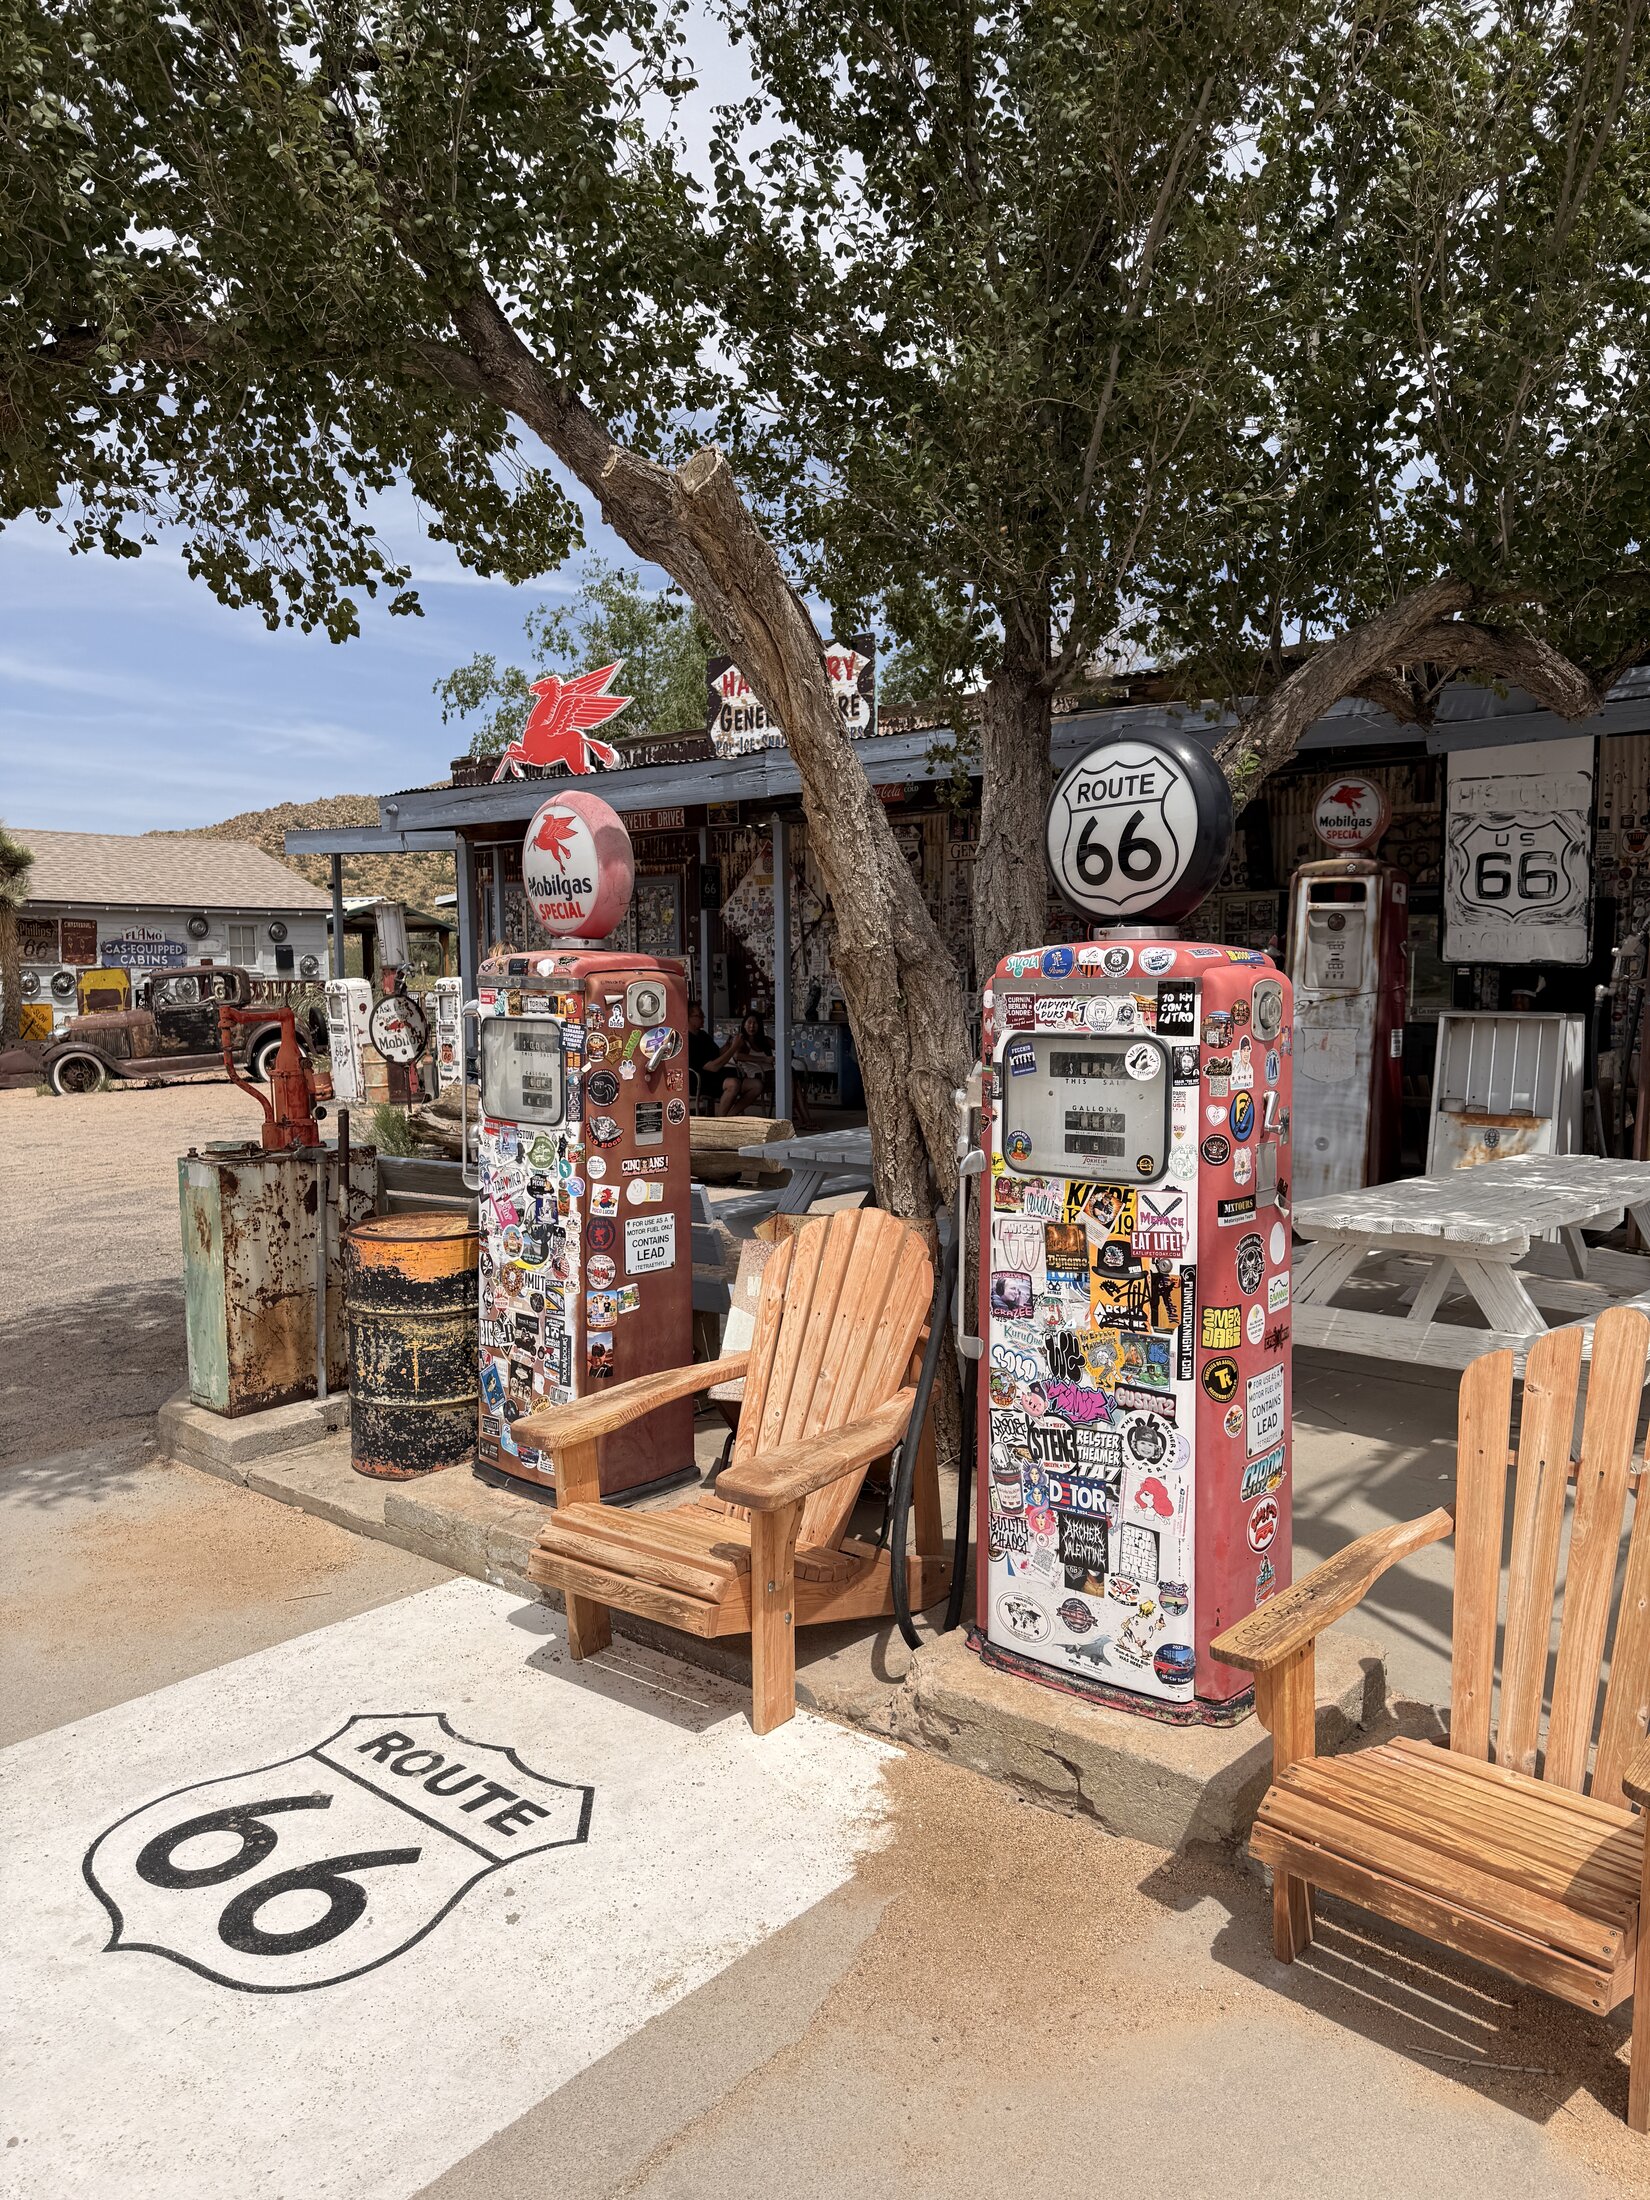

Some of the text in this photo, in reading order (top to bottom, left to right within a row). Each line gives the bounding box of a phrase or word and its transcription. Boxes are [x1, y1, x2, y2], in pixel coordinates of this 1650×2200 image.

[1077, 773, 1155, 804] ROUTE
[618, 810, 681, 829] RVETTE DRIVE
[1319, 815, 1373, 830] Mobilgas
[1326, 829, 1363, 840] SPECIAL
[1495, 833, 1536, 846] US
[1076, 810, 1162, 886] 66
[1476, 851, 1558, 900] 66
[528, 874, 593, 901] Mobilgas
[704, 884, 717, 894] 66
[538, 901, 585, 920] SPECIAL
[125, 928, 162, 941] FLAMO
[24, 939, 49, 959] 66
[105, 943, 183, 955] GAS-EQUIPPED
[120, 954, 168, 965] CABINS
[1162, 993, 1193, 1003] 10 KM
[1161, 1003, 1182, 1012] CON
[1159, 1011, 1194, 1024] LITRO
[1072, 1105, 1119, 1113] GALLONS
[1224, 1198, 1253, 1214] MXTOURS
[632, 1220, 644, 1228] FOR
[644, 1219, 656, 1227] USE
[656, 1218, 663, 1226] AS
[1140, 1212, 1184, 1226] MENACE
[627, 1228, 645, 1237] MOTOR
[646, 1226, 660, 1234] FUEL
[632, 1234, 669, 1248] CONTAINS
[1132, 1232, 1181, 1251] EAT LIFE!
[637, 1246, 665, 1261] LEAD
[1252, 1394, 1282, 1418] CONTAINS
[1257, 1413, 1278, 1436] LEAD
[1121, 1416, 1176, 1449] THE ARCHER
[354, 1730, 552, 1837] ROUTE
[135, 1794, 423, 1957] 66
